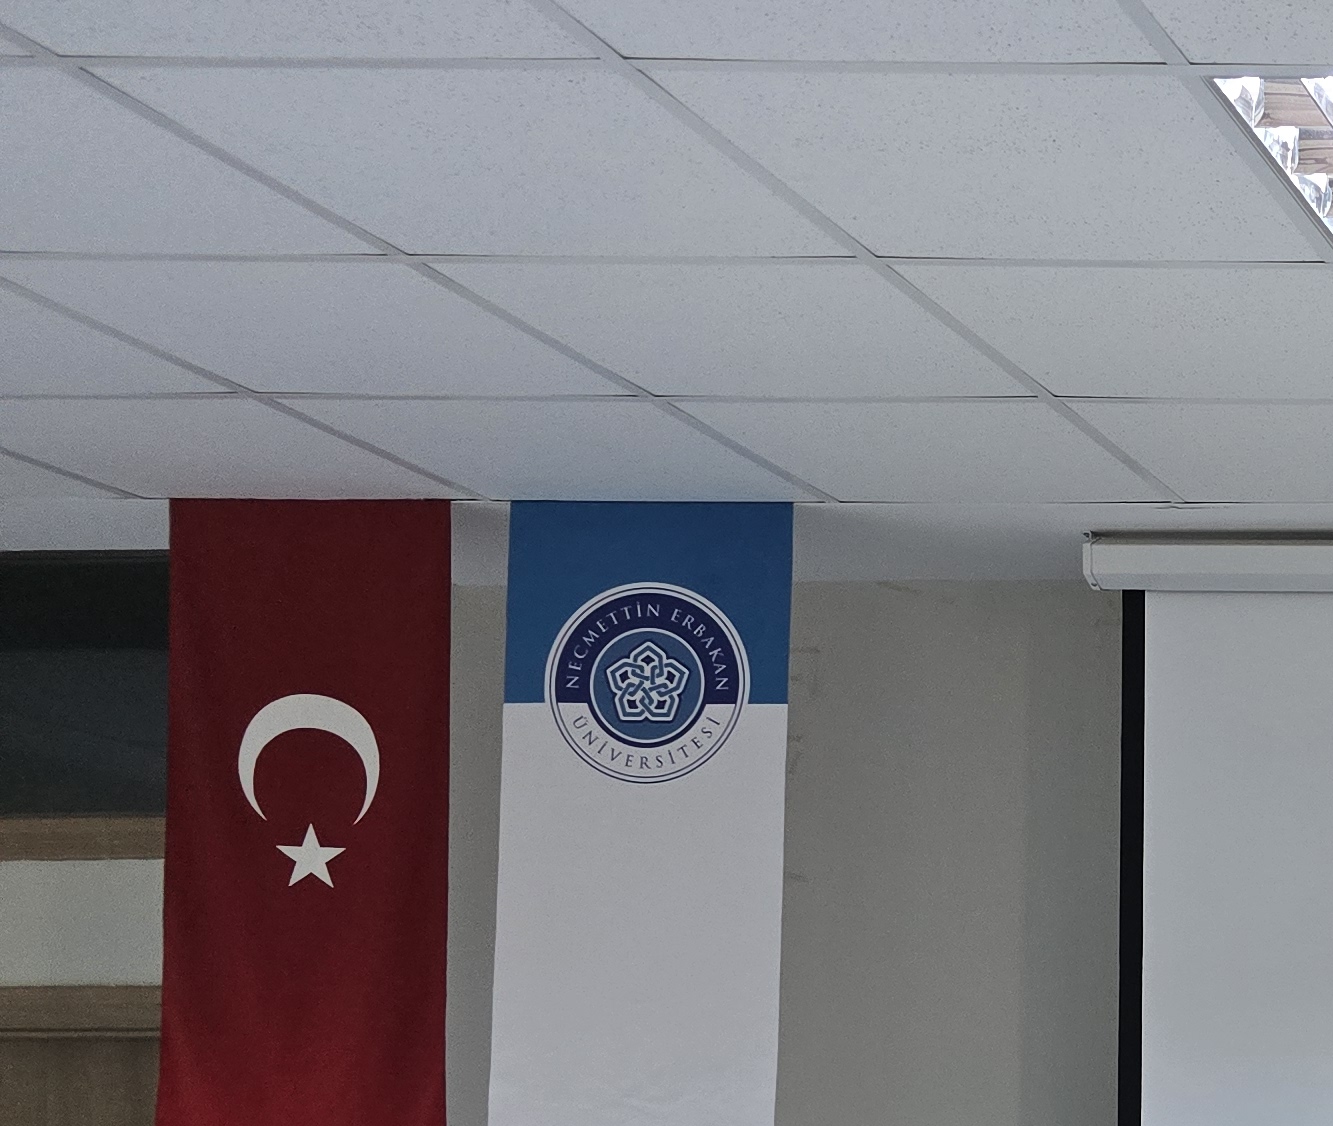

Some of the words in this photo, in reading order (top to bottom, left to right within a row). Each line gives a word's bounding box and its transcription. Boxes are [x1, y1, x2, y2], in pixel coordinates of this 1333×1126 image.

[566, 601, 660, 689] NECMETTİN
[670, 608, 728, 691] ERBAKAN
[573, 715, 721, 770] ÜNİVERSİTESİ
